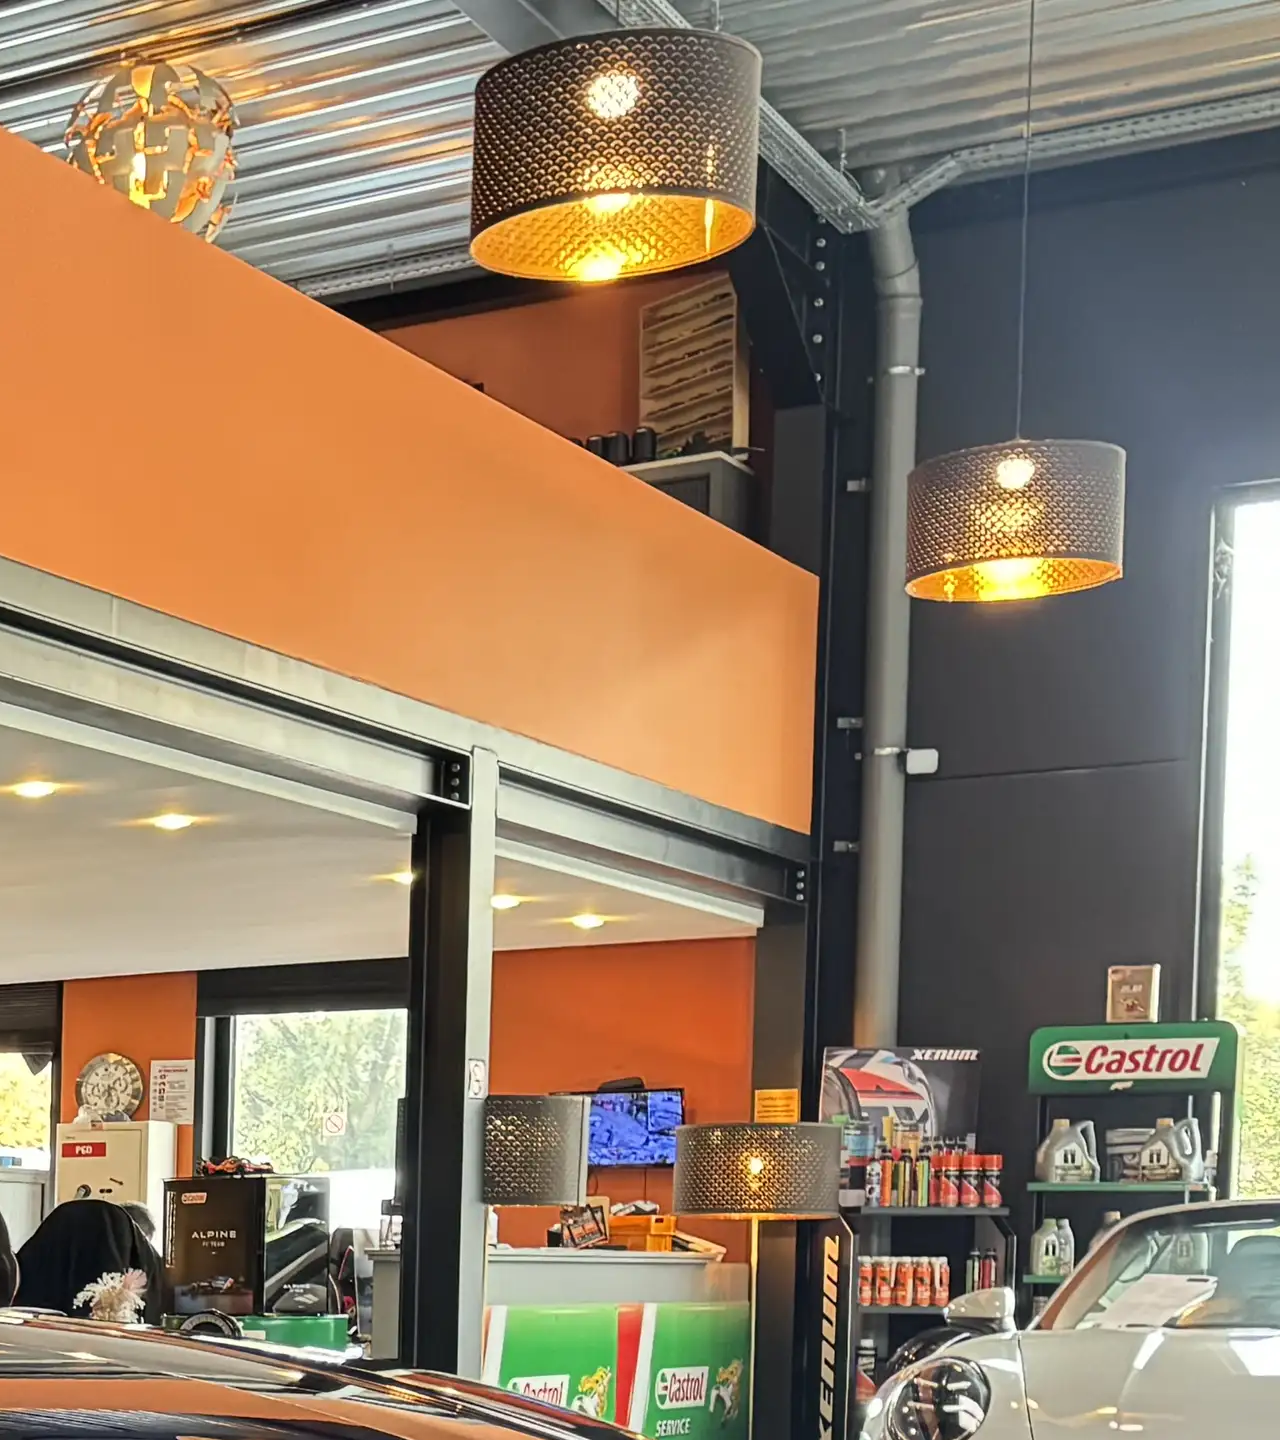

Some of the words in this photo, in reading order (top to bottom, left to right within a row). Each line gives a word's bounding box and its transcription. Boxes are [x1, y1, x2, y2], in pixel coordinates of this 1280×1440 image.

[1085, 1044, 1205, 1075] Castrol
[191, 1230, 237, 1239] ALPINE
[668, 1372, 705, 1403] Castrol
[655, 1418, 691, 1437] SERVICE
